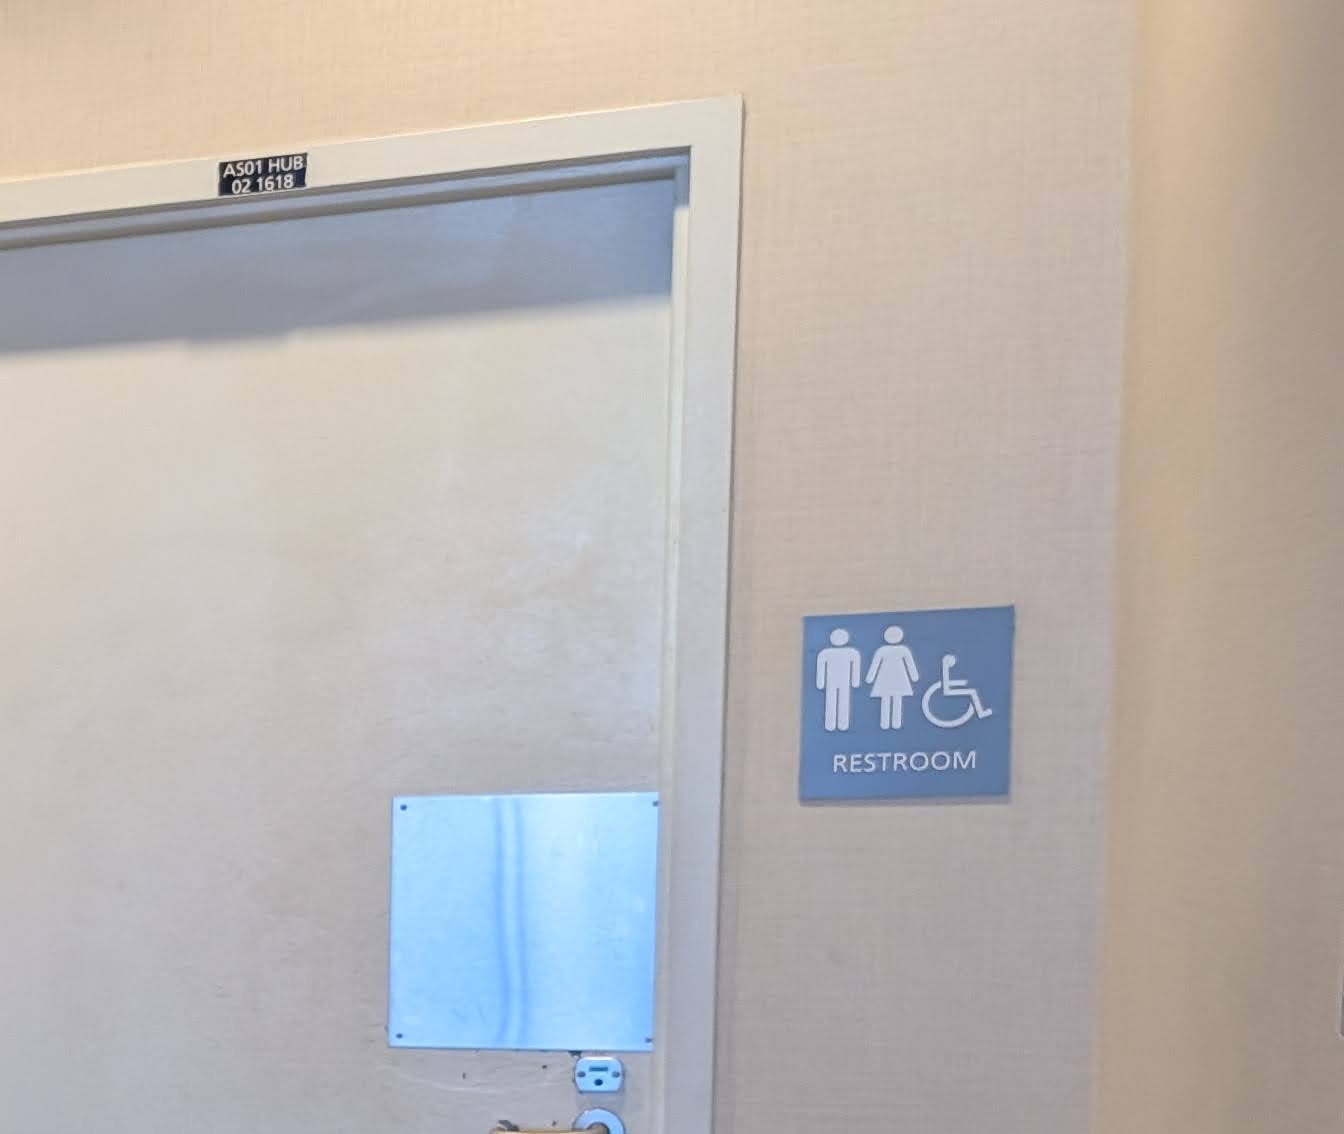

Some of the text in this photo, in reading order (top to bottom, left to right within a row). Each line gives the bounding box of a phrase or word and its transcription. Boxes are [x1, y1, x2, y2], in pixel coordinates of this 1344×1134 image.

[268, 156, 304, 173] HUB
[232, 174, 294, 194] 02 1618
[833, 751, 977, 773] RESTROOM
